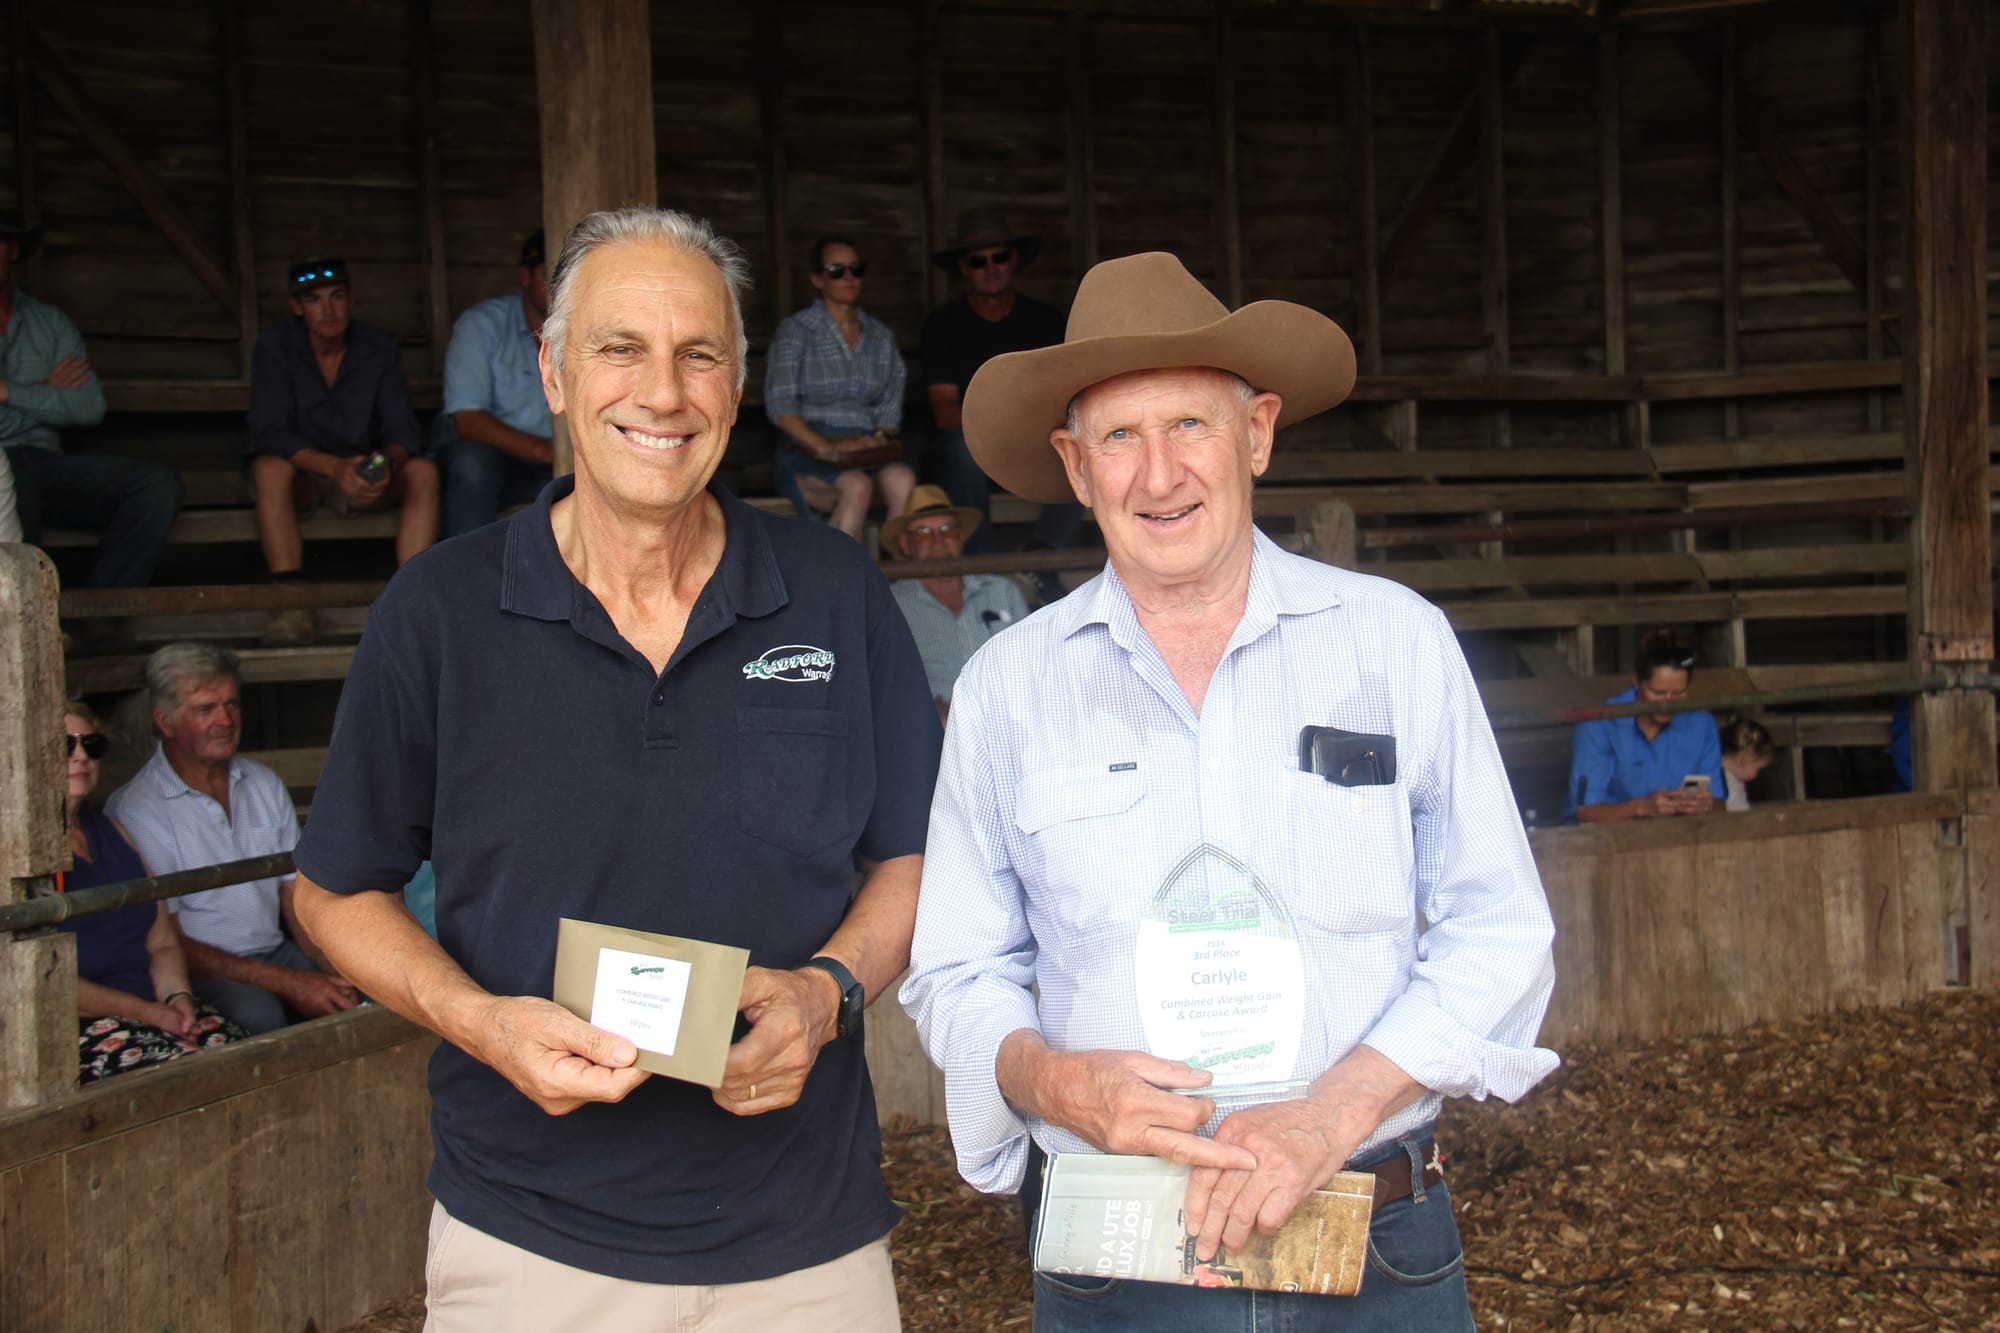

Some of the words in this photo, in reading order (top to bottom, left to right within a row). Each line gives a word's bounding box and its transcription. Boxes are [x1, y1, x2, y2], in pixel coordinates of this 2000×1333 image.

[801, 668, 832, 682] Warrag
[1168, 909, 1216, 924] Steer
[1222, 903, 1260, 919] Trial
[1193, 950, 1210, 960] 3rd
[1213, 948, 1241, 960] Place
[1191, 967, 1248, 986] Carlyle
[1160, 995, 1214, 1009] Combined
[1216, 993, 1254, 1005] Weight
[1257, 991, 1282, 1001] Gain
[1176, 1010, 1186, 1021] &
[1189, 1008, 1229, 1020] Carcase
[1232, 1003, 1268, 1016] Award
[1102, 1199, 1122, 1236] UTE
[1122, 1199, 1141, 1237] JOB
[1100, 1239, 1117, 1253] A
